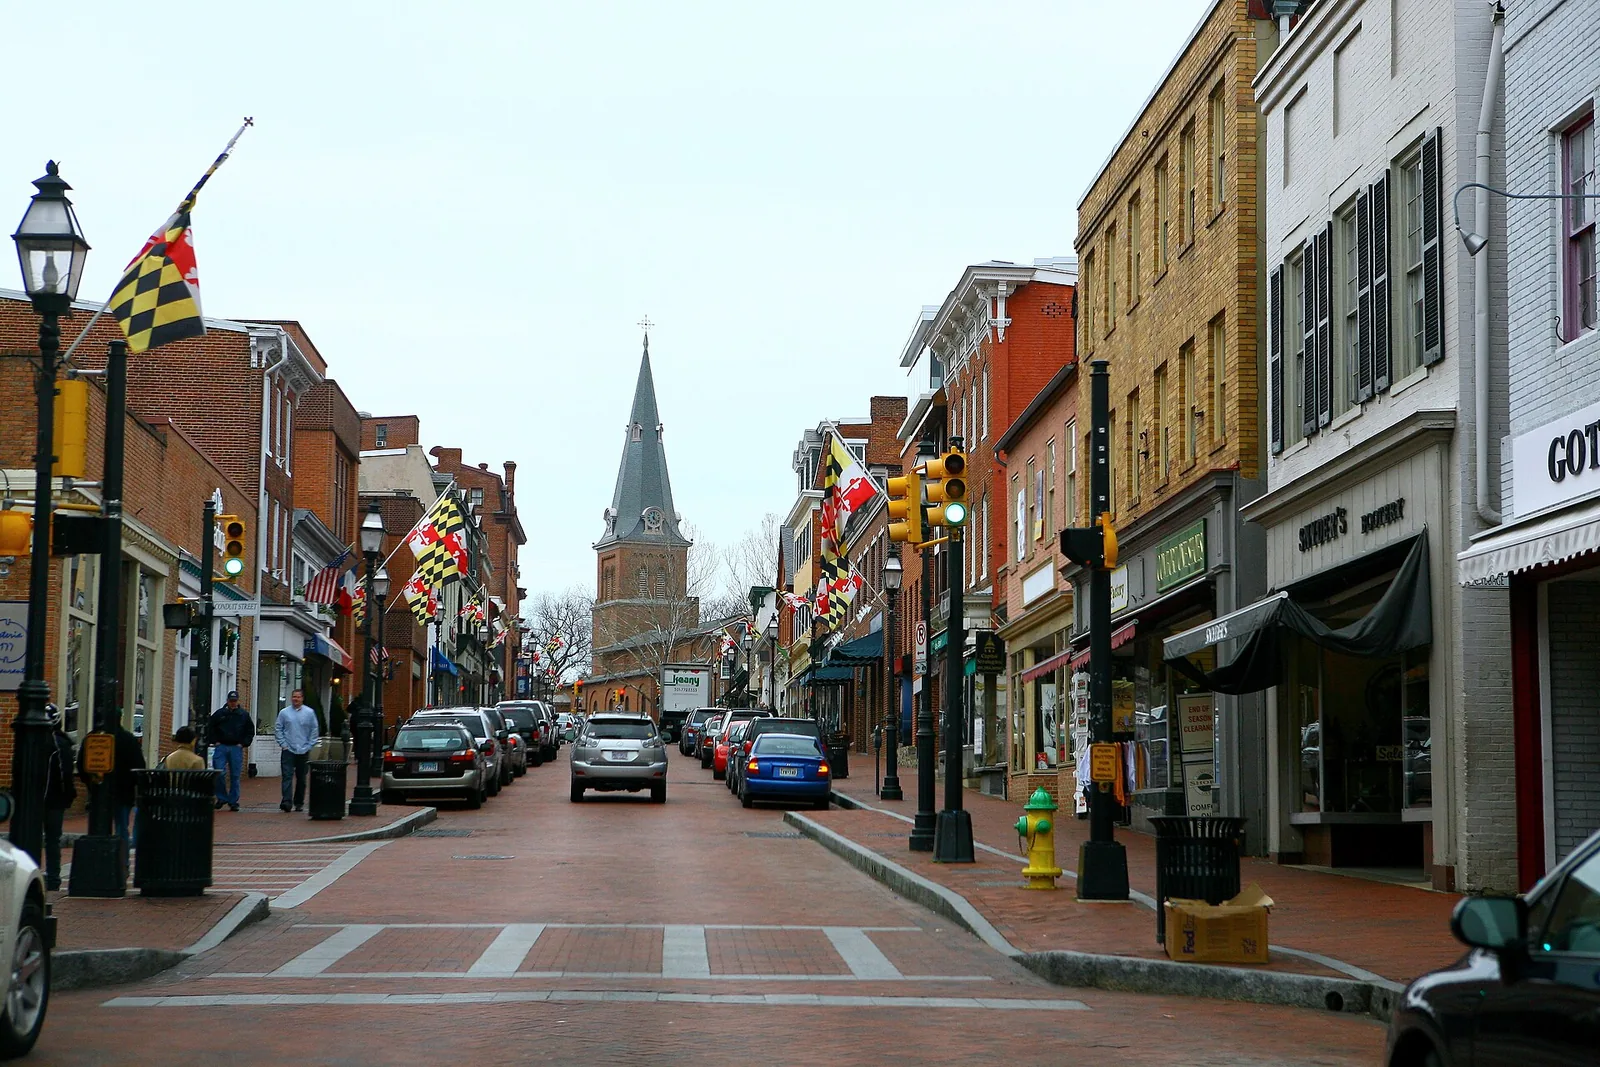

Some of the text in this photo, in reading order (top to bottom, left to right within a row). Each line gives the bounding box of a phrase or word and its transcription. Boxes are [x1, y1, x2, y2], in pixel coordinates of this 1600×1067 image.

[1548, 419, 1600, 483] GOT
[1298, 497, 1405, 553] SNYDER'S BOOTERY
[214, 602, 257, 611] CONDUIT STREET
[1202, 704, 1210, 712] OF
[1188, 714, 1213, 722] SEASON
[1378, 747, 1404, 760] Sale
[1190, 803, 1213, 811] COMF
